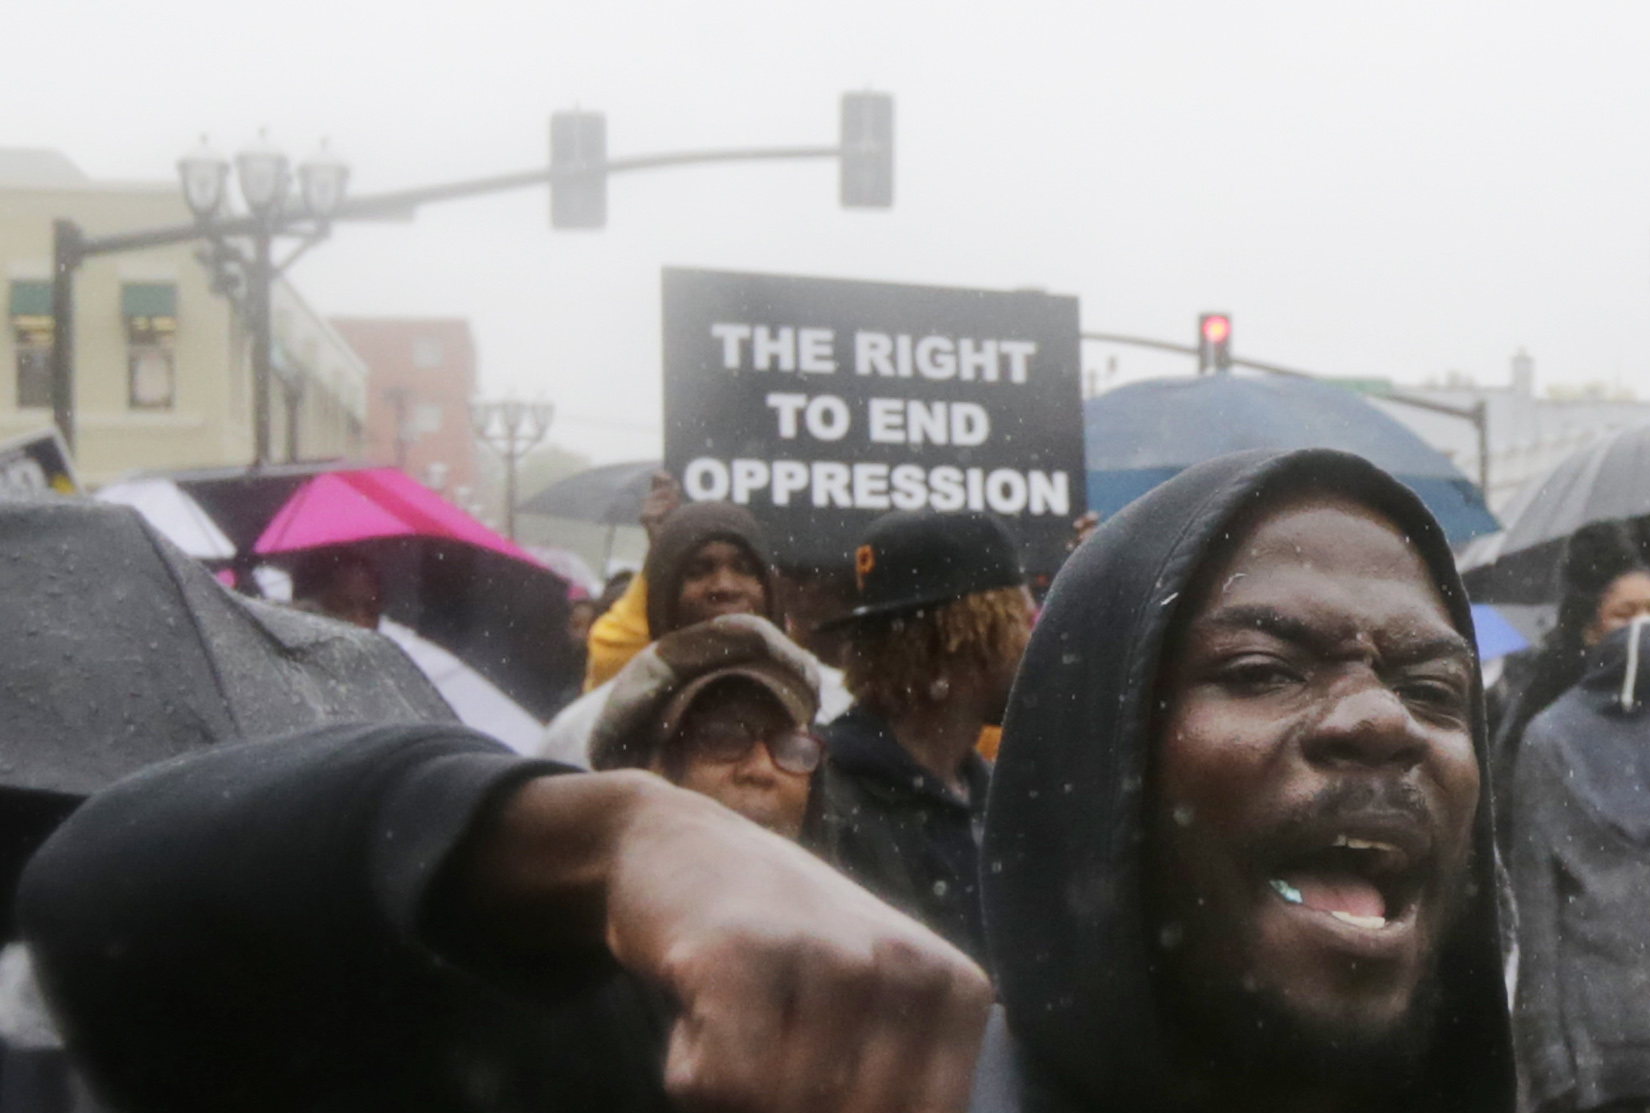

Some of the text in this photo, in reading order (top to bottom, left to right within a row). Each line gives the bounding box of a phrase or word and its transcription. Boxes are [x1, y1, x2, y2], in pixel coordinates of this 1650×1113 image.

[711, 322, 1037, 384] THE RIGHT
[767, 393, 991, 447] TO END
[683, 456, 1071, 516] OPPRESSION
